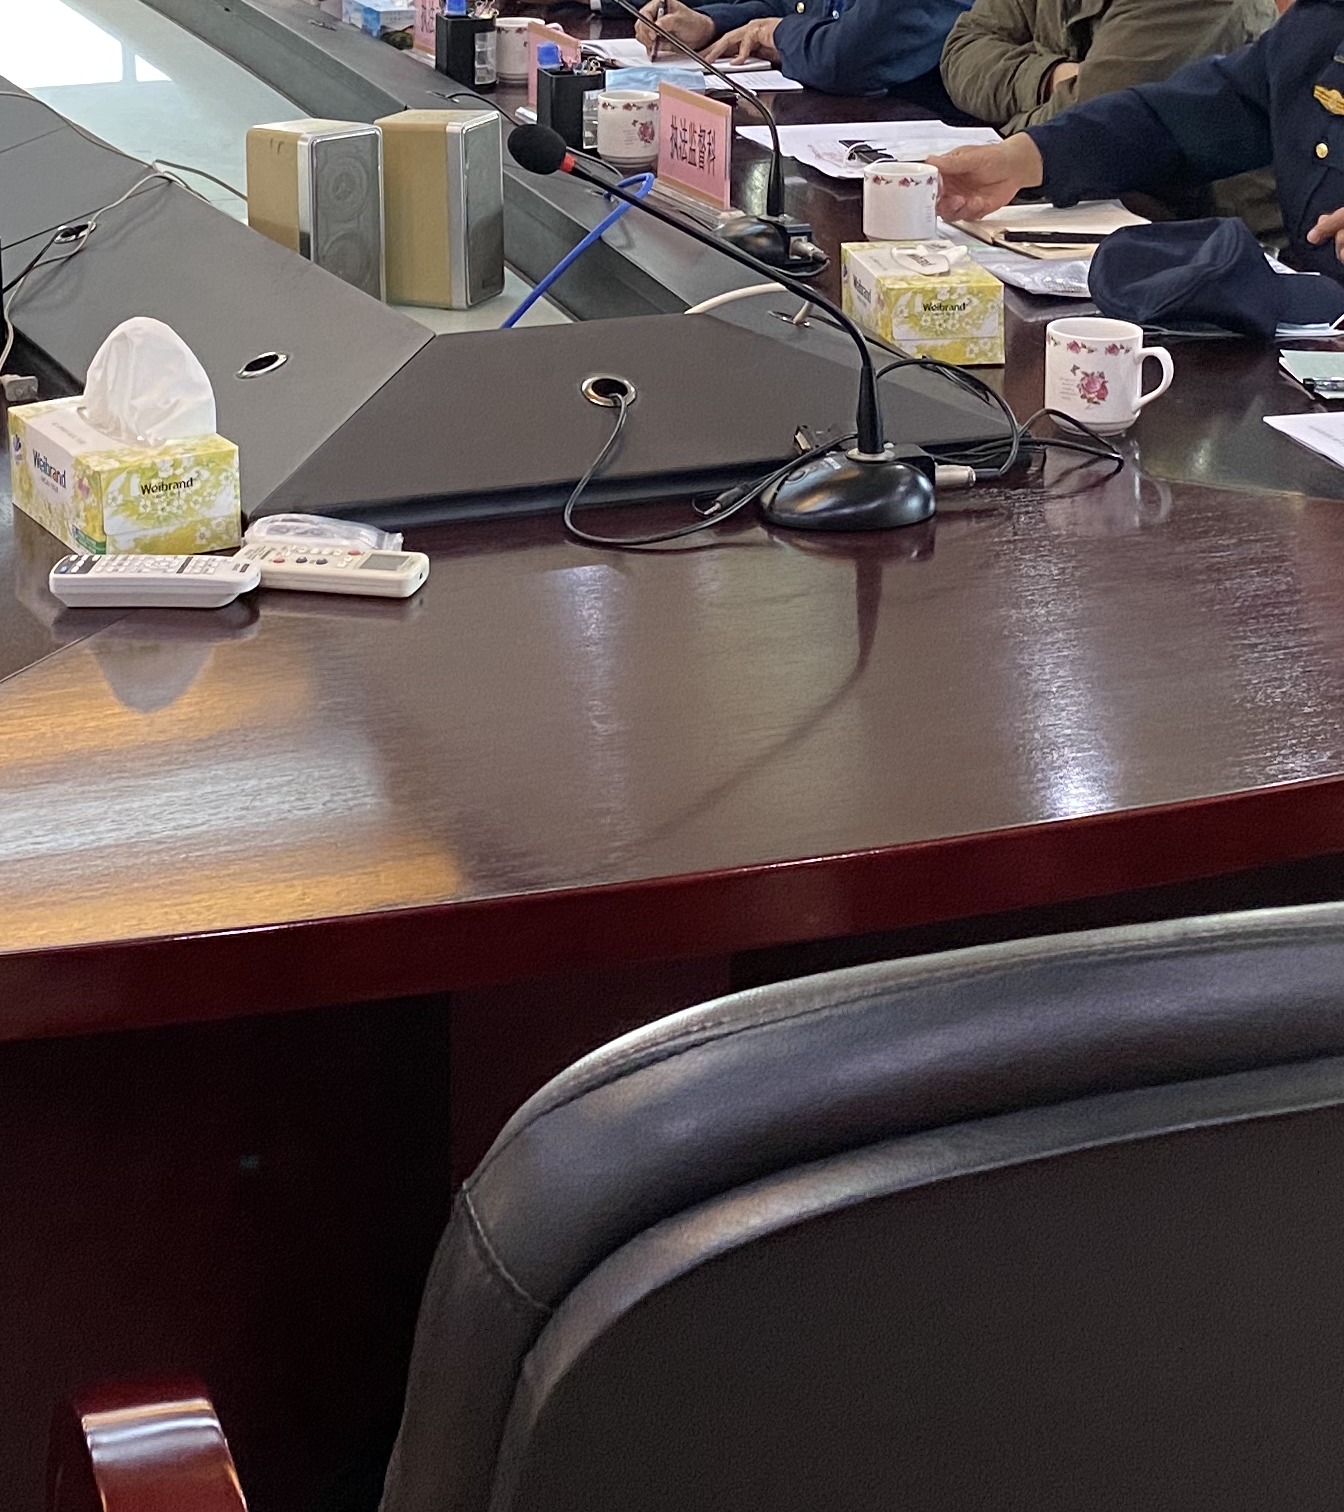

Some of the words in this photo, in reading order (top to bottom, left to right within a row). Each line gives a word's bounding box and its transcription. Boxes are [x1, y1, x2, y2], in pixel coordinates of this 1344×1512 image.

[670, 114, 716, 177] 执法监督科
[922, 302, 966, 312] Weibrand
[33, 448, 67, 489] Weibrand
[141, 477, 193, 495] Weibrand
